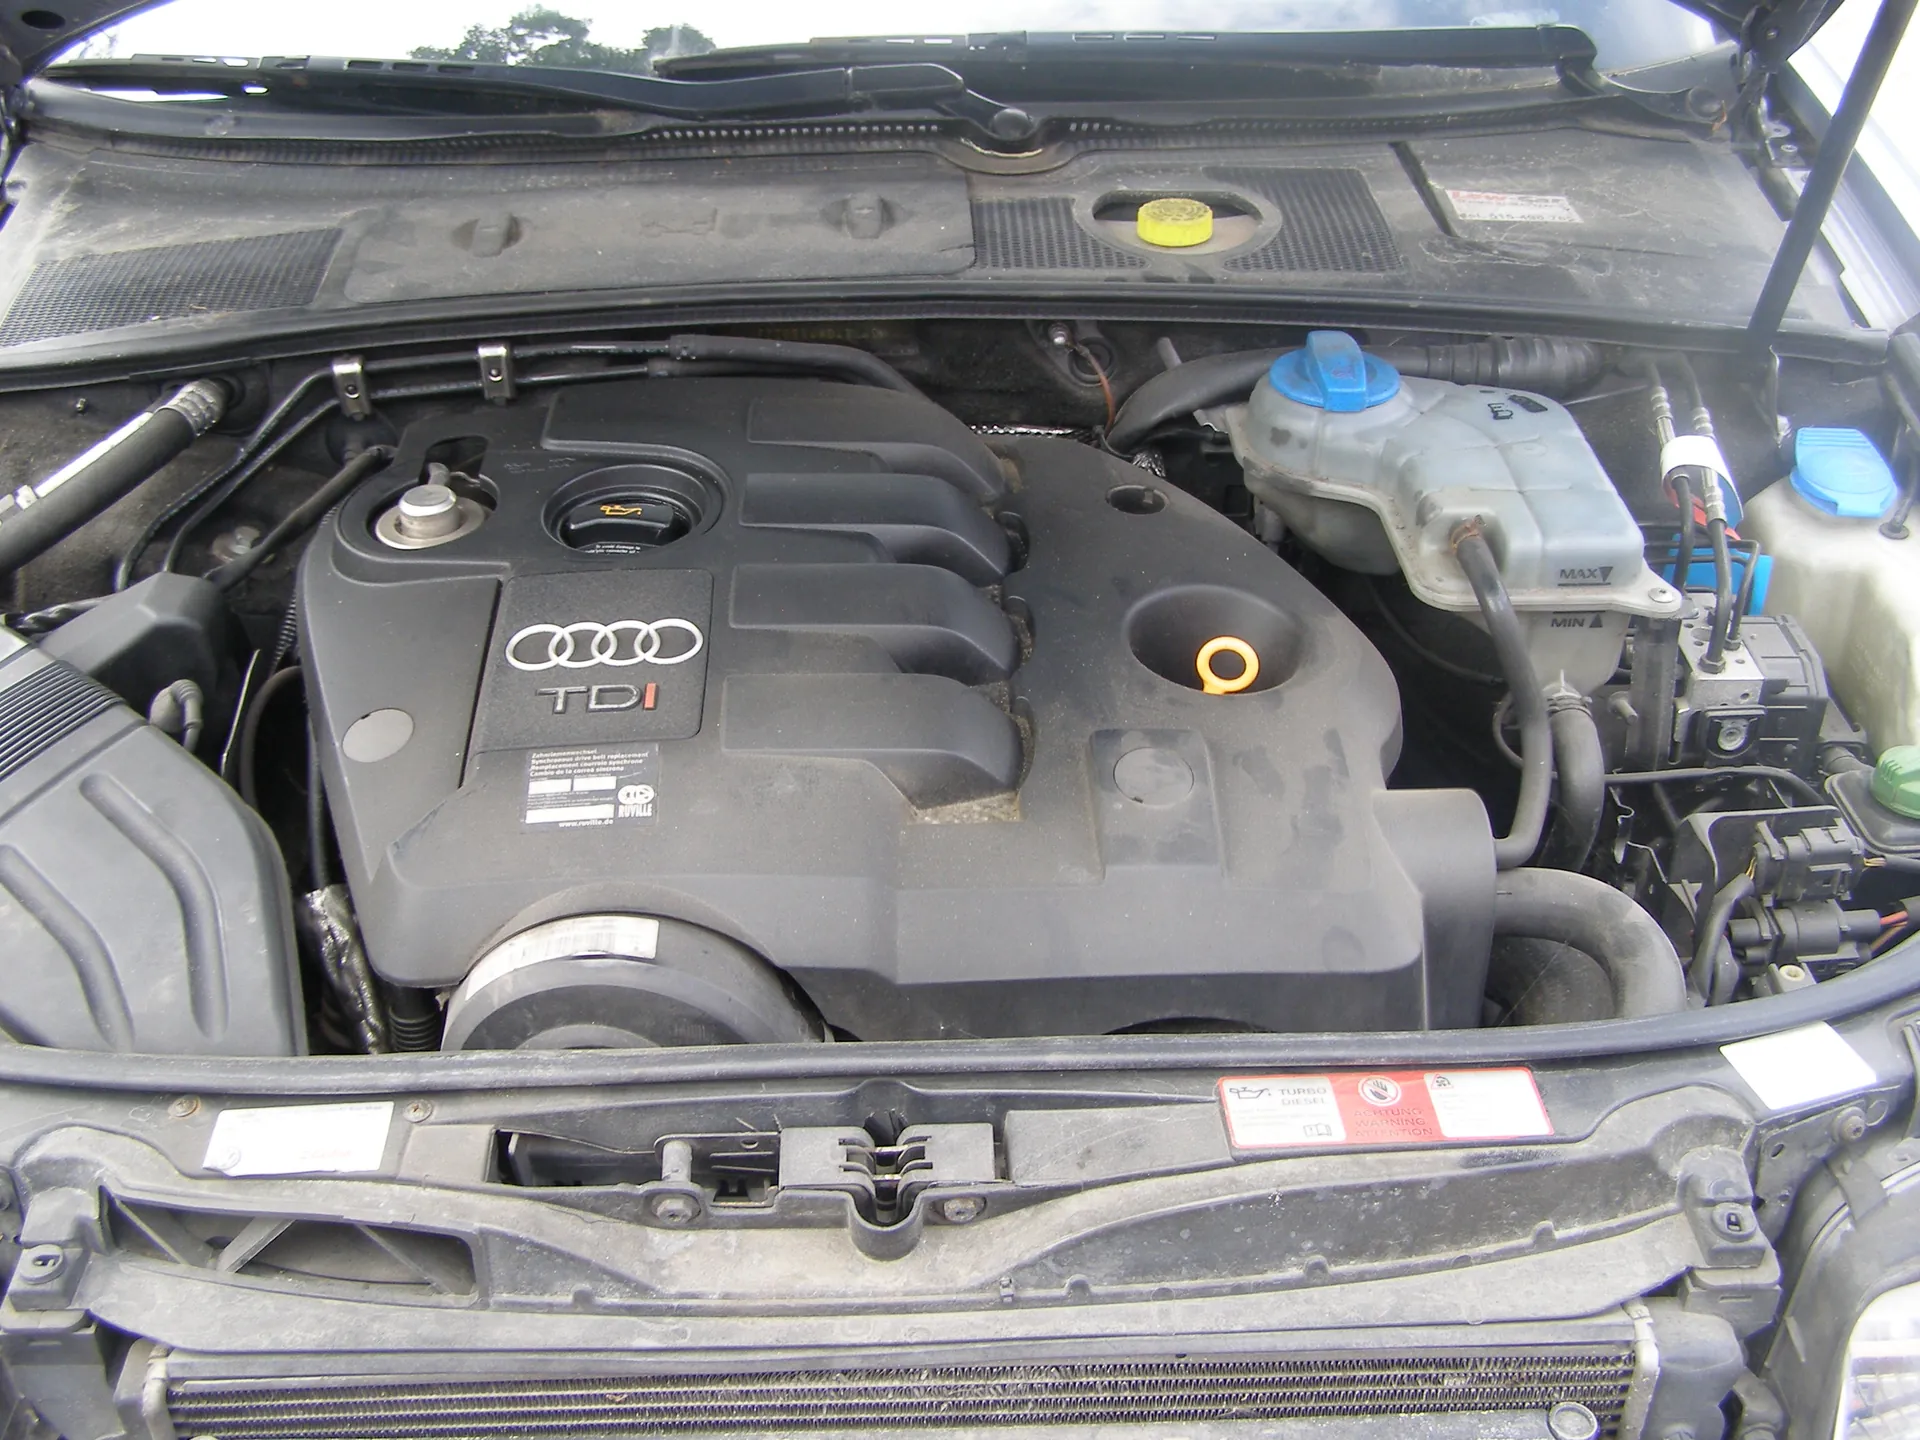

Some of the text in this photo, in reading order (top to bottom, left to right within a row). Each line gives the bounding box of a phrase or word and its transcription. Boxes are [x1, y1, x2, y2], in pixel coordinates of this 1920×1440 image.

[1559, 568, 1598, 579] MAX
[1550, 618, 1585, 627] MIN
[535, 682, 659, 714] TDI
[606, 750, 649, 761] replacement
[530, 762, 579, 771] Remplacement
[608, 758, 643, 767] synchrone
[530, 769, 555, 777] Cambio
[617, 803, 653, 818] RUVILLE
[559, 818, 614, 828] www.ruville.de
[1278, 1086, 1328, 1096] TURBO
[1281, 1096, 1327, 1106] DIESEL
[1353, 1107, 1424, 1117] ACHTUNG
[1354, 1117, 1427, 1128] WARNING
[1354, 1127, 1434, 1138] ATTENTION
